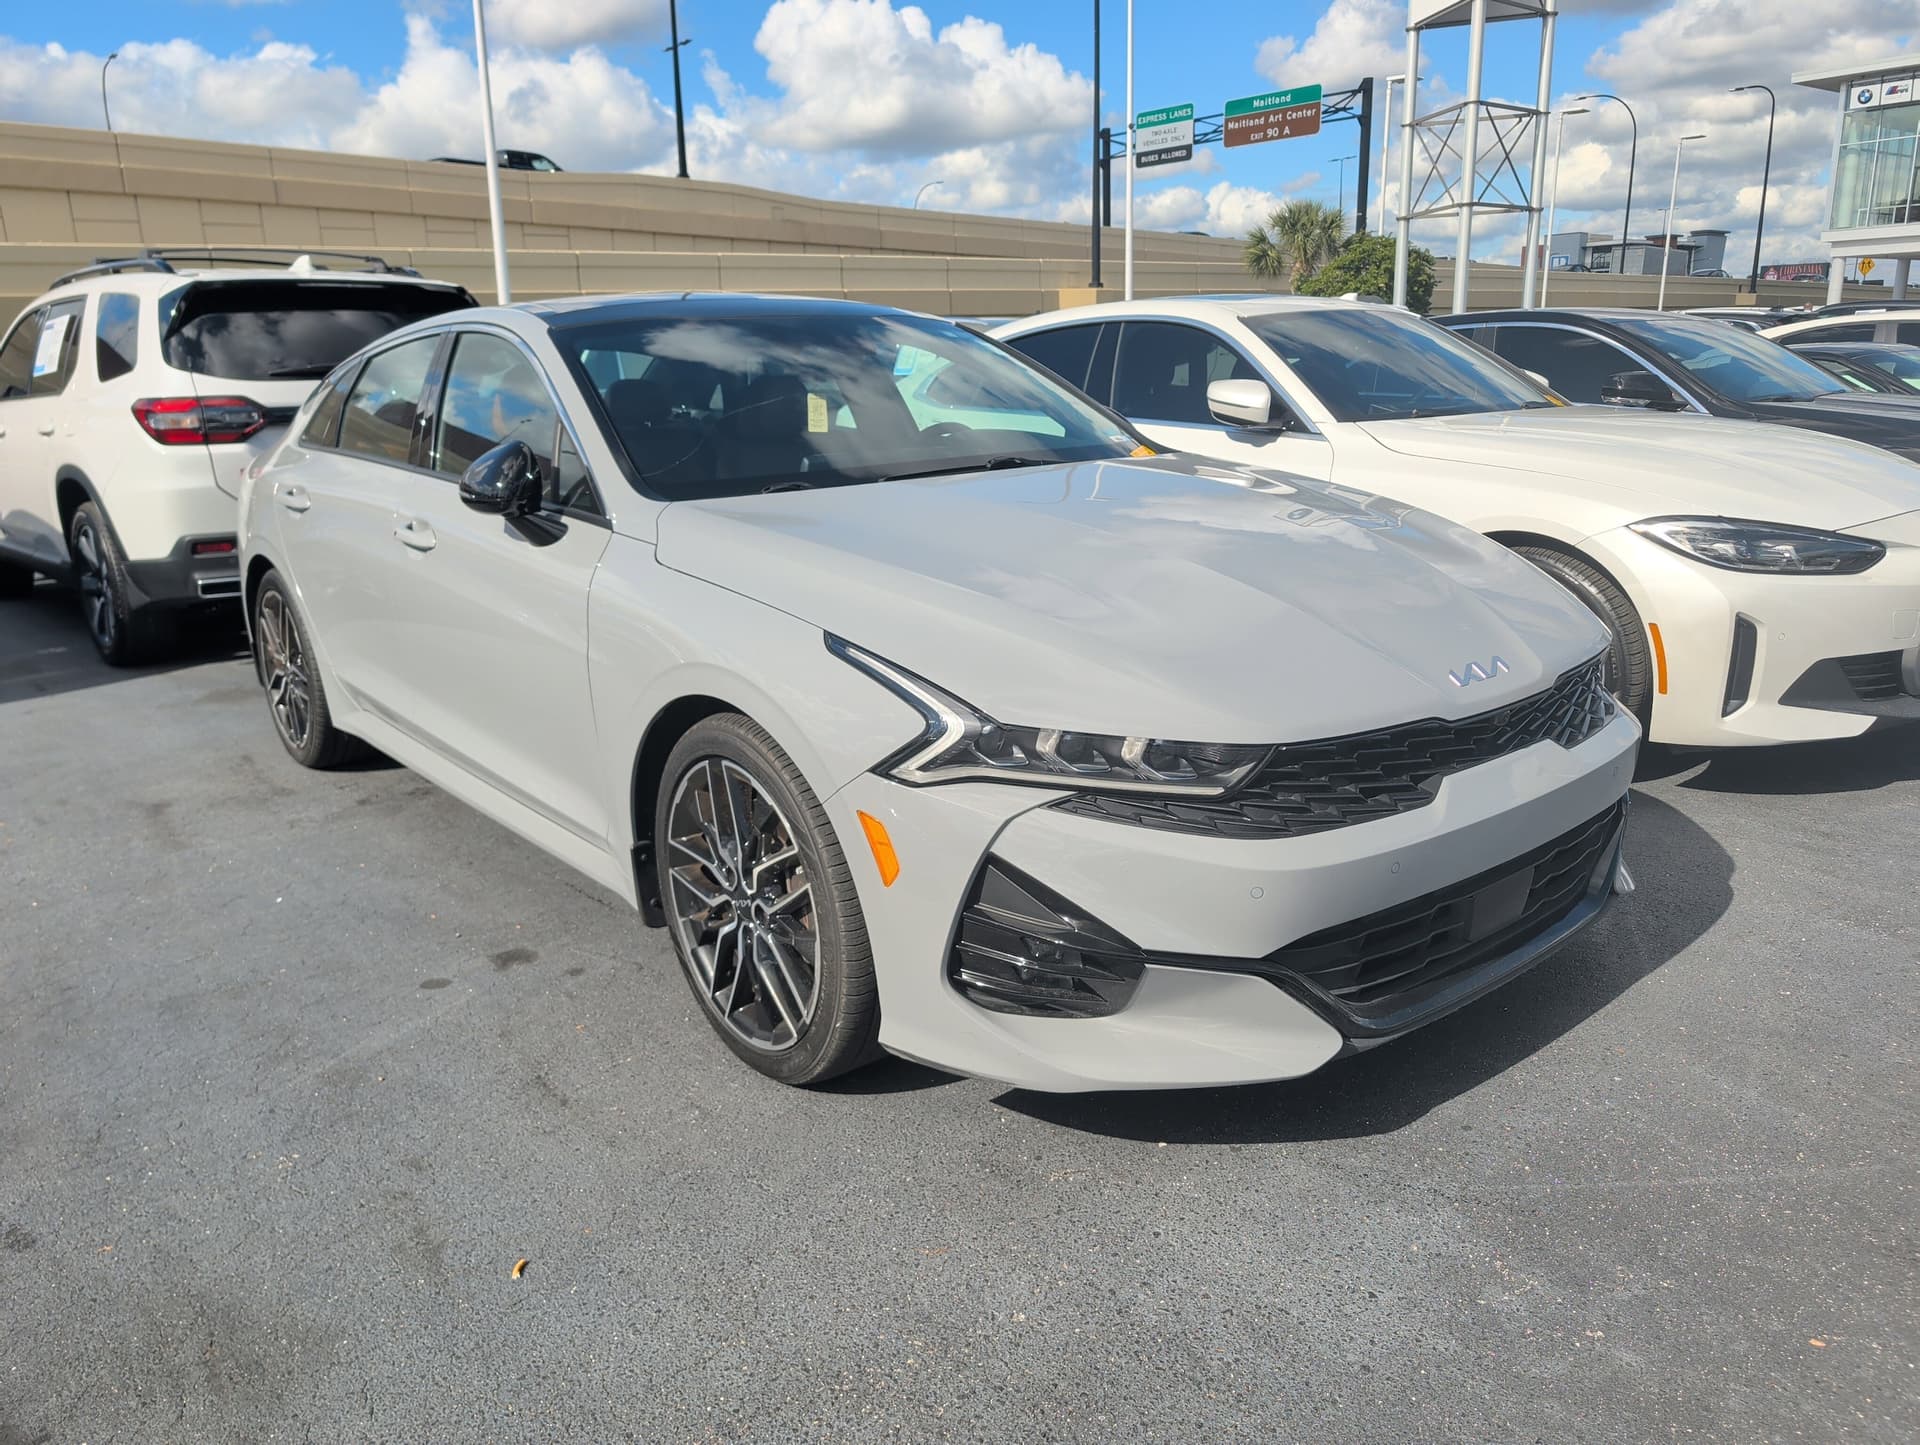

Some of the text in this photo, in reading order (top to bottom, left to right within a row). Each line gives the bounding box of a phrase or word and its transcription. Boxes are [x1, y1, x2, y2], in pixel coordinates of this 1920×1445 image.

[1253, 93, 1291, 108] Maitland
[1138, 108, 1192, 124] EXPRESS LANES
[1227, 108, 1316, 130] Maitland Art Center
[1250, 125, 1290, 141] EXIT 90 A
[1141, 150, 1187, 163] BUSES ALLOWED
